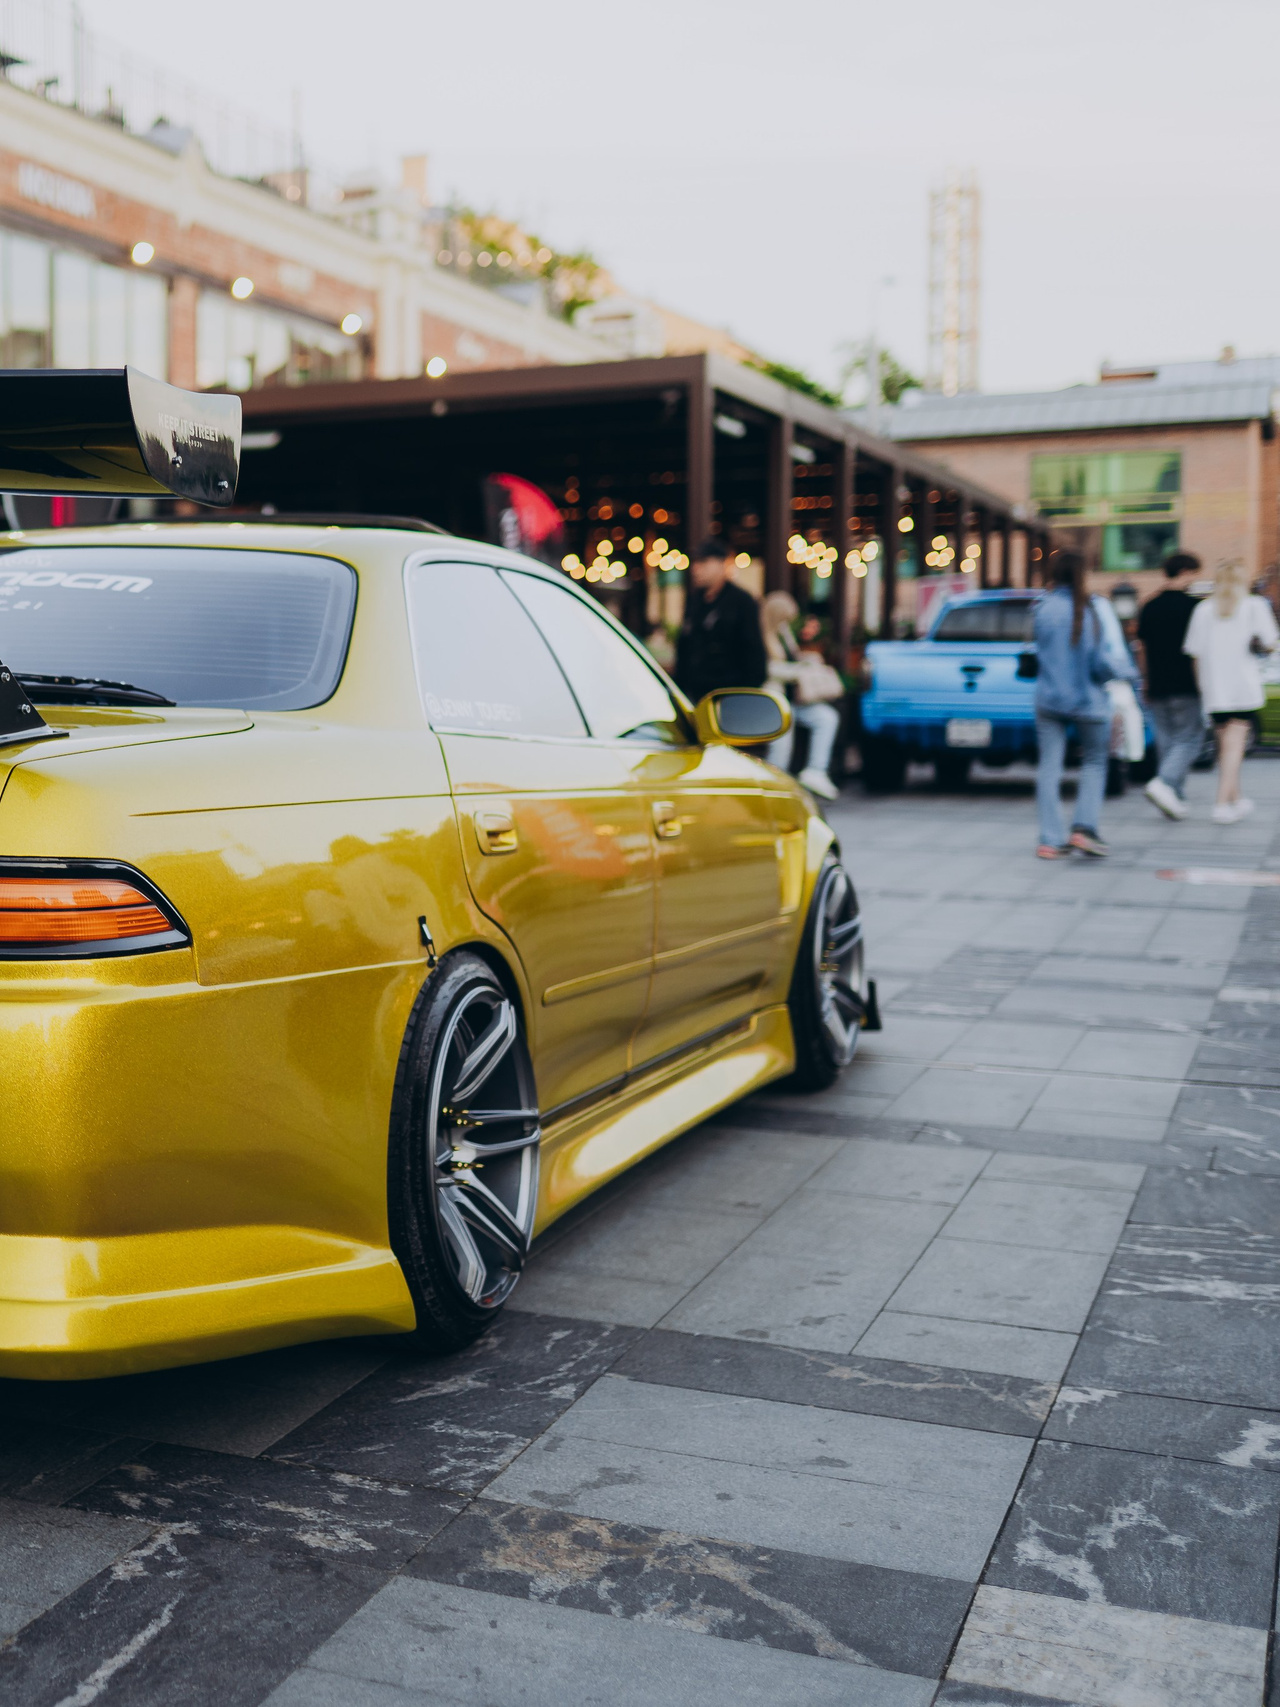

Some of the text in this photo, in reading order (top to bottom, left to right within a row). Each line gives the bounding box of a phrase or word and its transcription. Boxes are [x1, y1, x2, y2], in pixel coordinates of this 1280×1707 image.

[158, 412, 219, 442] KEEP IT STREET
